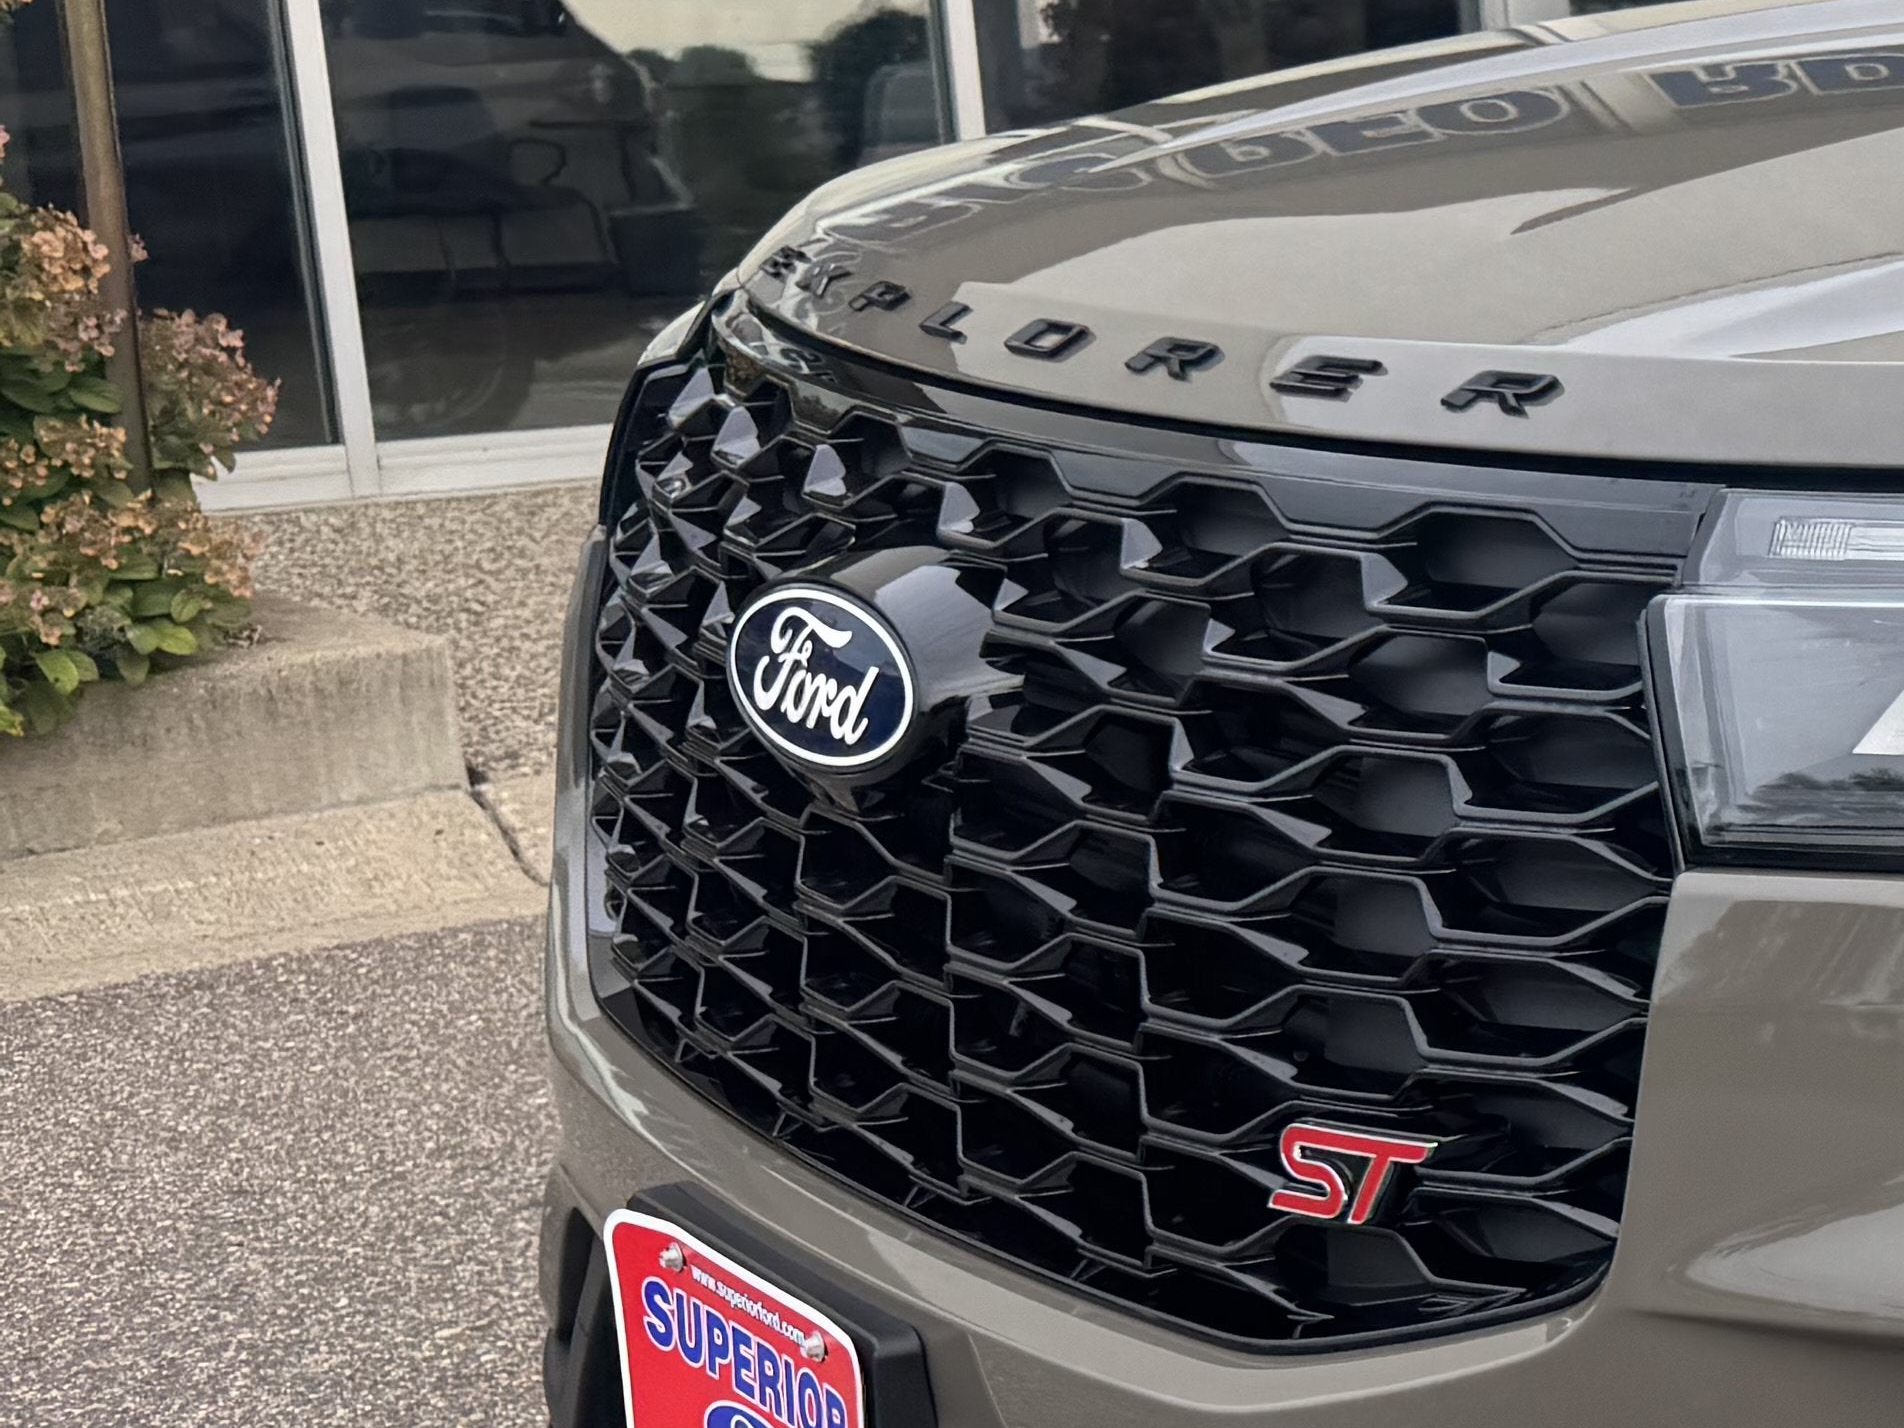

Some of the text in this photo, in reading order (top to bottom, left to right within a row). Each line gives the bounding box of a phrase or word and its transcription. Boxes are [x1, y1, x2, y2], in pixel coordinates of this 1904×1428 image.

[760, 245, 1566, 418] EXPLORER
[753, 606, 881, 747] Ford
[1267, 1122, 1438, 1225] ST
